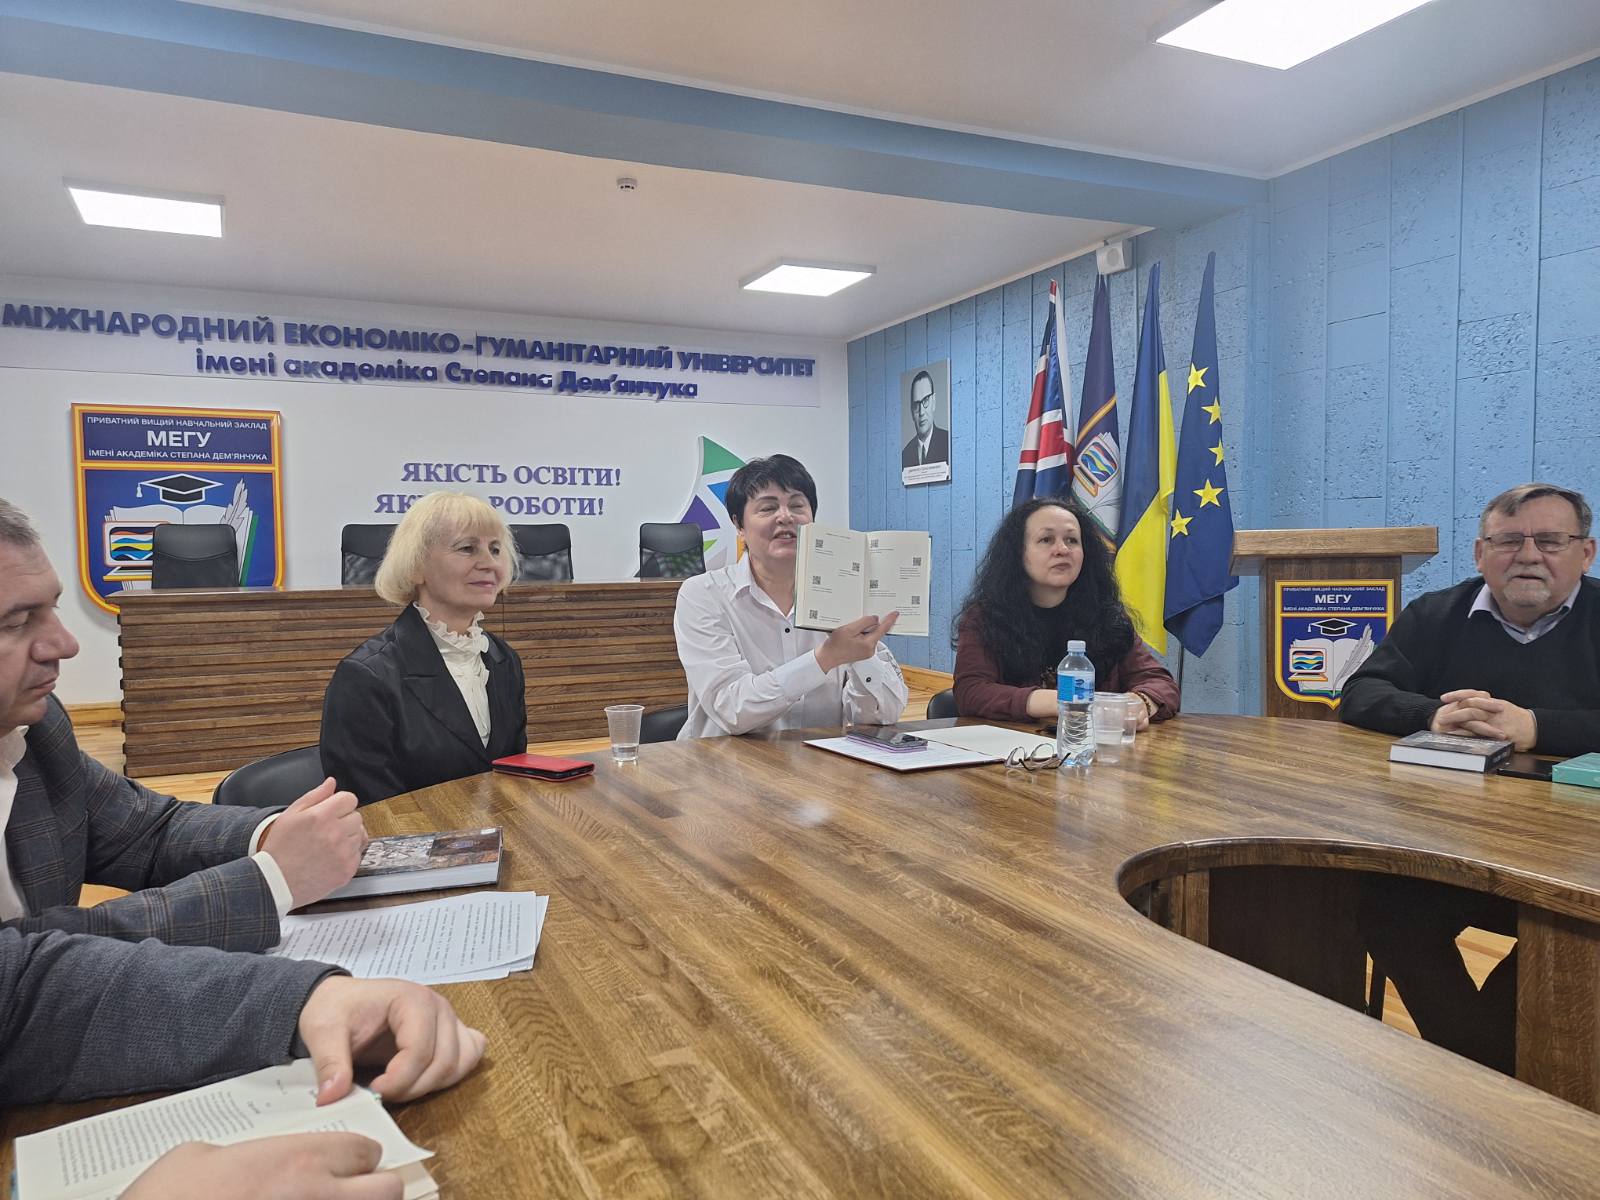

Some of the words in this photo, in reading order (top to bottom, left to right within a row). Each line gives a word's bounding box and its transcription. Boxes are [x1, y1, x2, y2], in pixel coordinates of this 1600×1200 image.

[2, 303, 275, 343] МІЖНАРОДНИЙ
[283, 322, 672, 369] ЕКОНОМІКО-ГУМАНІТАРНИЙ
[677, 351, 816, 377] УНІВЕРСИТЕТ
[196, 348, 277, 376] імені
[284, 359, 438, 381] академіка
[445, 361, 553, 388] Степана
[87, 416, 140, 425] ПРИВАТНИЙ
[141, 418, 175, 427] ВИЩИЙ
[176, 419, 233, 429] НАВЧАЛЬНИЙ
[234, 421, 268, 430] ЗАКЛАД
[146, 430, 211, 448] МЕГУ
[170, 451, 211, 460] СТЕПАНА
[212, 452, 268, 461] ДЕМ'ЯНЧУКА
[401, 462, 508, 484] ЯКІСТЬ
[513, 465, 621, 487] ОСВІТИ!
[488, 495, 604, 517] РОБОТИ!
[1315, 594, 1352, 604] МЕГУ
